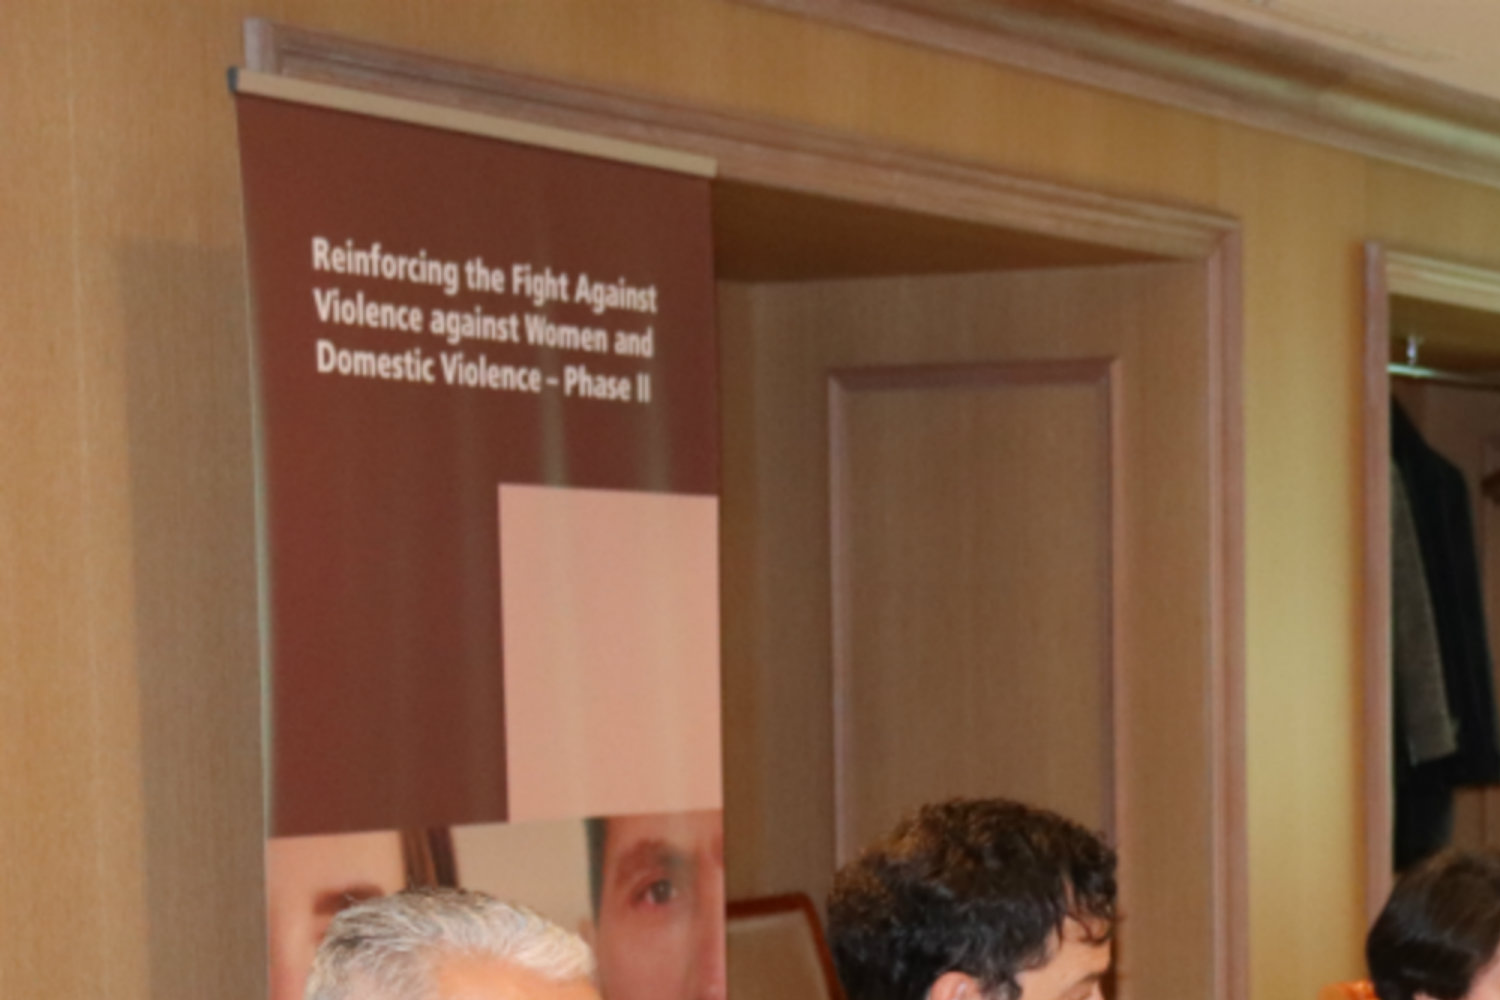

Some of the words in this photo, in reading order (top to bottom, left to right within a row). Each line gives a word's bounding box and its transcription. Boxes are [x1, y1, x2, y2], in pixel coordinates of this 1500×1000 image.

[312, 236, 459, 295] Reinforcing
[465, 257, 505, 293] the
[512, 263, 569, 305] Fight
[576, 273, 658, 314] Against
[313, 288, 423, 333] Violence
[430, 306, 519, 344] against
[525, 313, 608, 353] Women
[614, 327, 654, 358] and
[316, 339, 435, 383] Domestic
[441, 351, 541, 392] Violence
[564, 365, 631, 401] Phase
[637, 373, 651, 402] II
